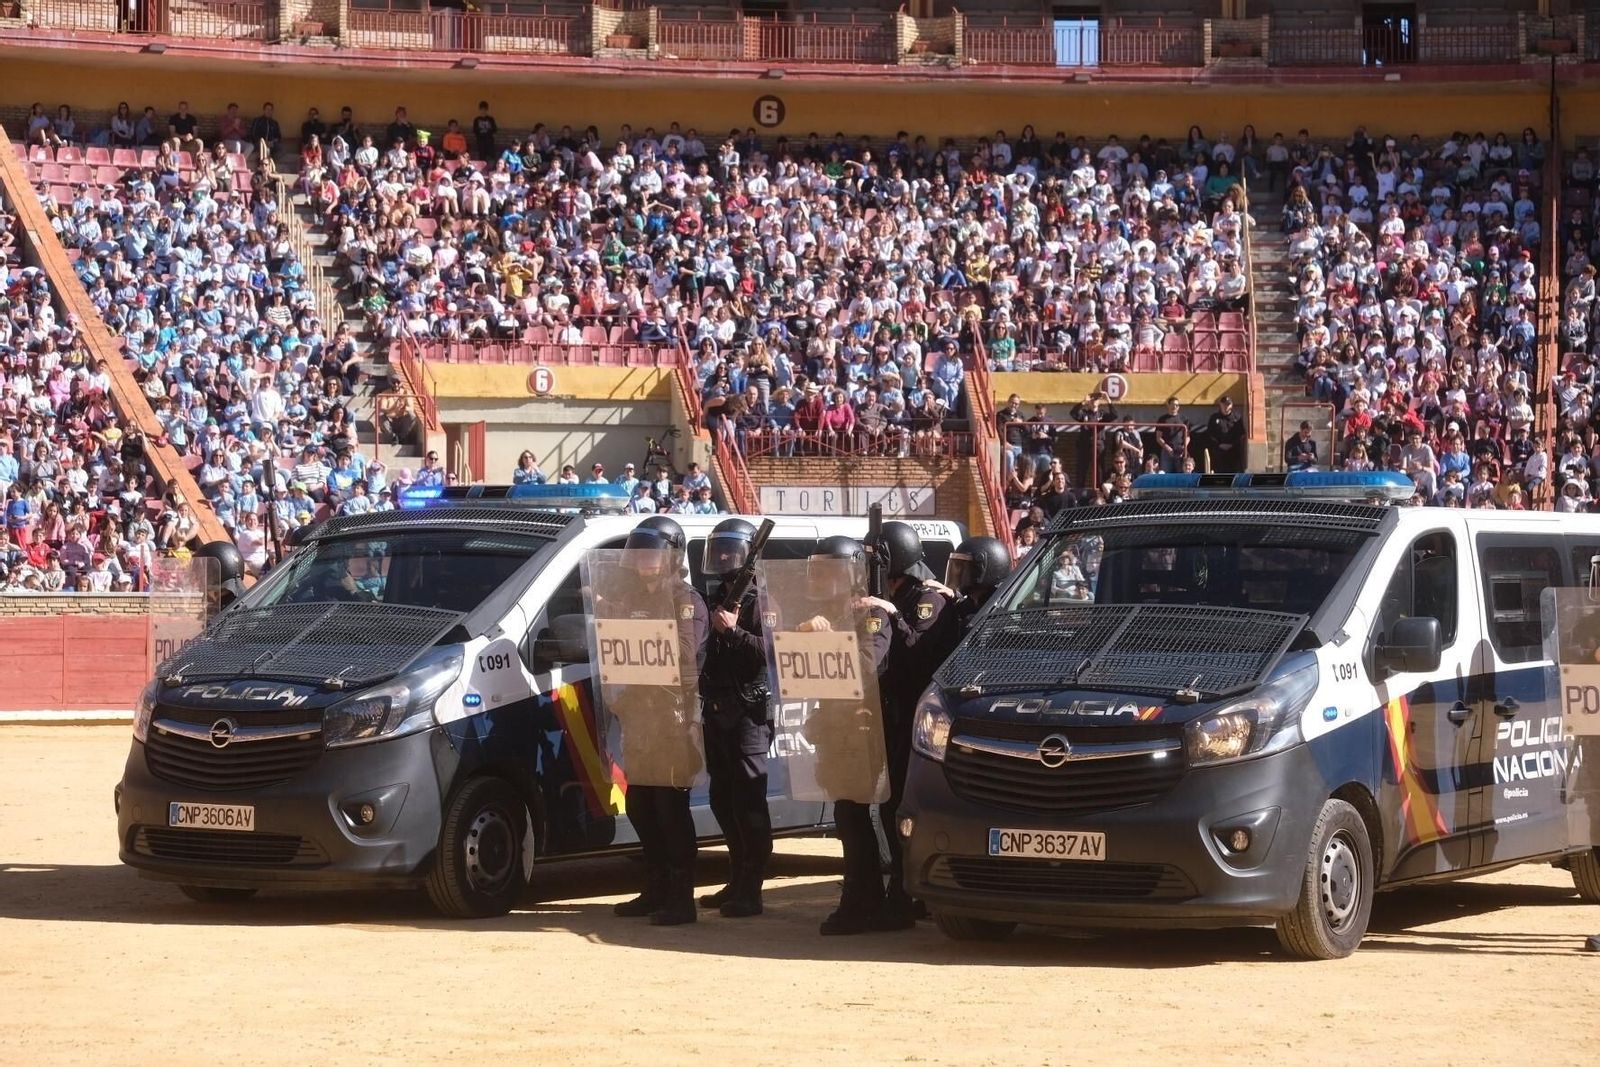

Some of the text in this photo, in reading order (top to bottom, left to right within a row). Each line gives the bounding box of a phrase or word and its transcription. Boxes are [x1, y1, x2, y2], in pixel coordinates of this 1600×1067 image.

[760, 100, 778, 124] 6
[536, 370, 548, 392] 6
[1108, 377, 1119, 398] 6
[775, 489, 919, 512] TORILES
[909, 523, 951, 536] PR-72A
[486, 653, 511, 671] 091
[1339, 662, 1358, 680] 091
